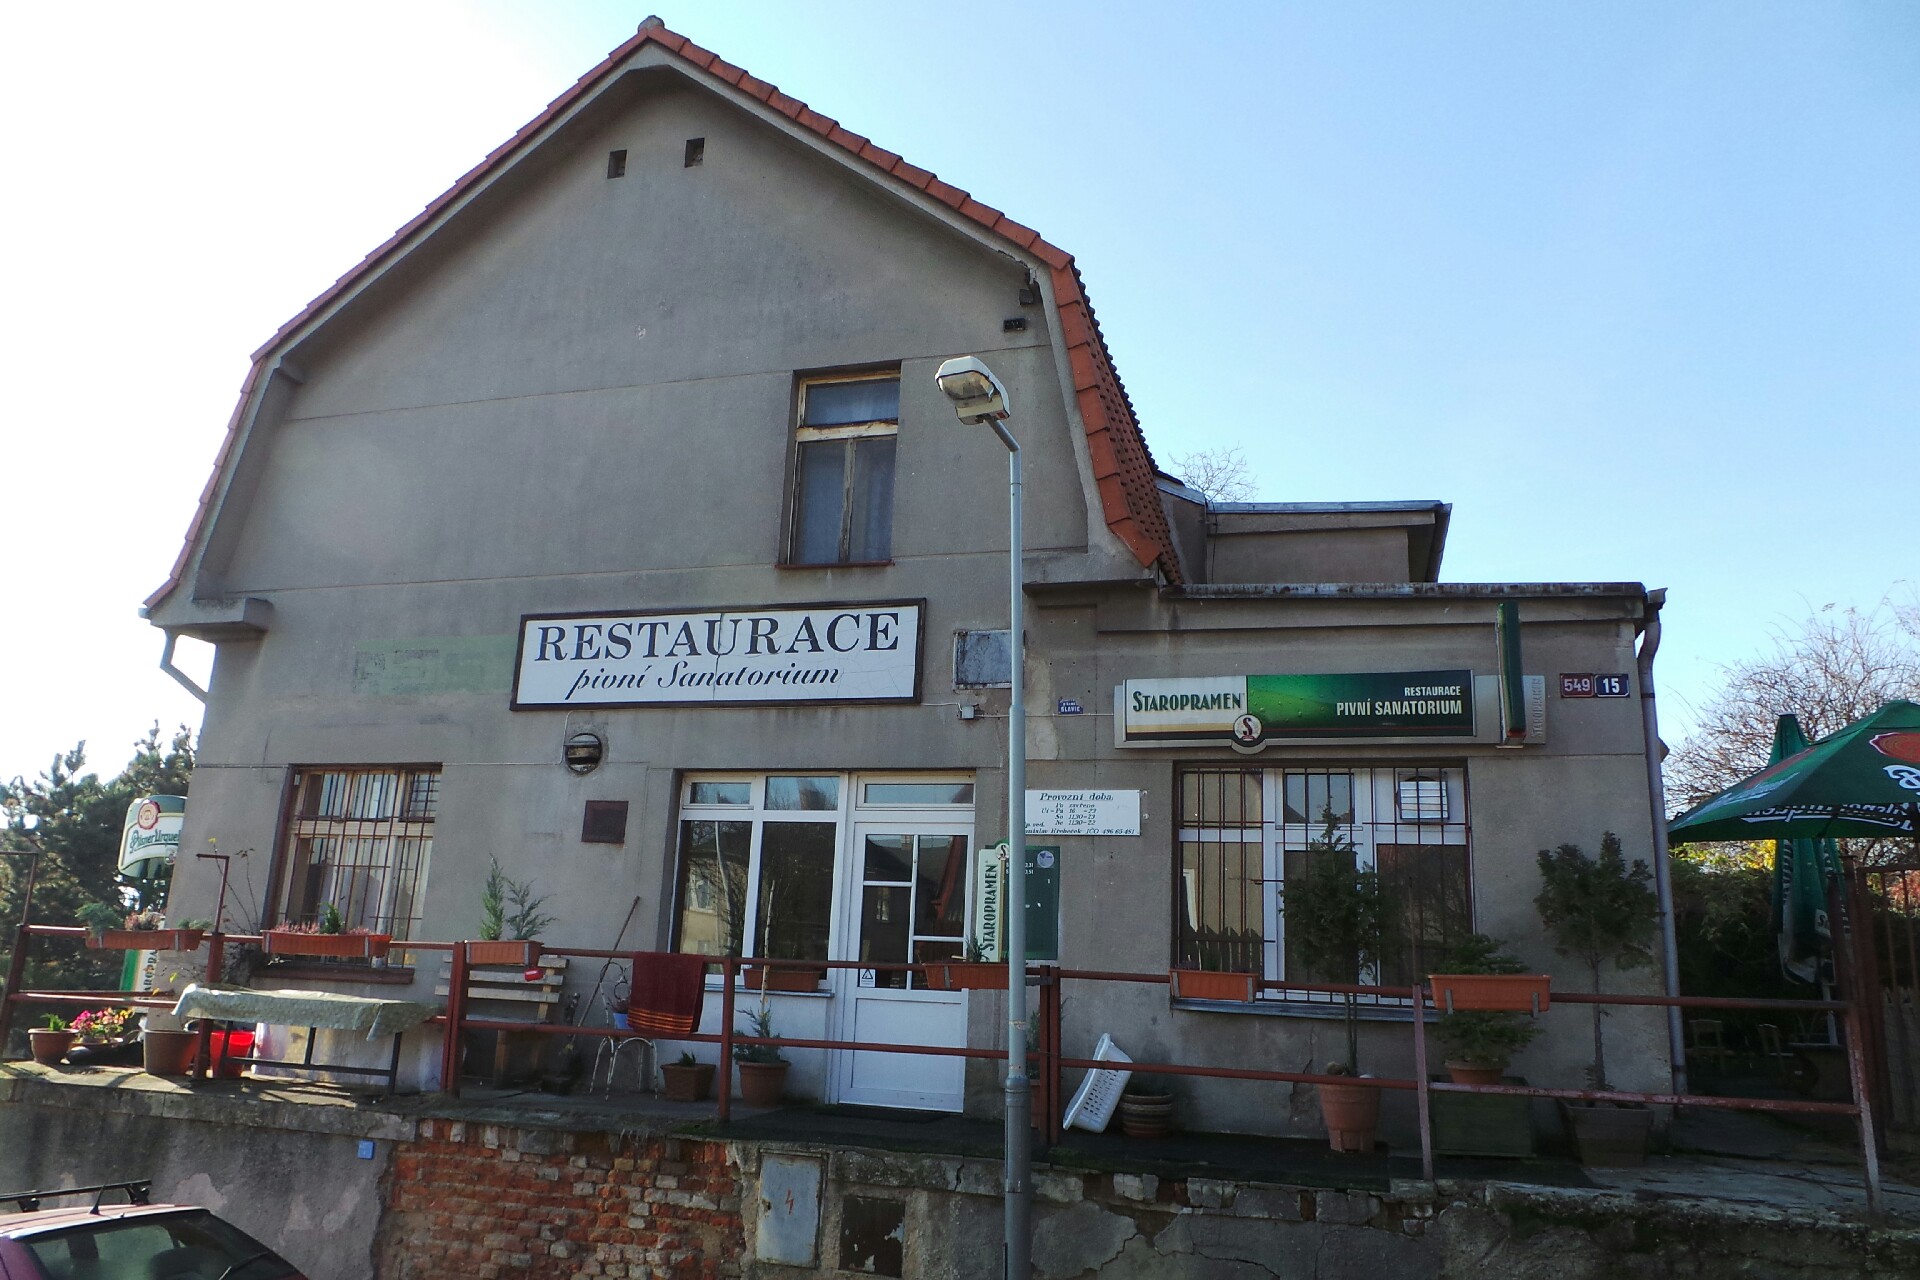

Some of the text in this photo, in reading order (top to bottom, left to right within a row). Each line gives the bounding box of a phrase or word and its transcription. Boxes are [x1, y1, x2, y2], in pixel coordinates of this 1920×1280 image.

[534, 612, 900, 662] RESTAURACE
[565, 661, 841, 700] pivní Sanatorium
[1564, 678, 1591, 692] 549
[1603, 677, 1620, 694] 15
[1404, 685, 1462, 697] RESTAURACE
[1132, 690, 1242, 712] STAROPRAMEN
[1336, 698, 1463, 717] PIVNÍ SANATORIUM
[155, 829, 181, 848] Urquel
[982, 864, 998, 952] STAROPRAMEN
